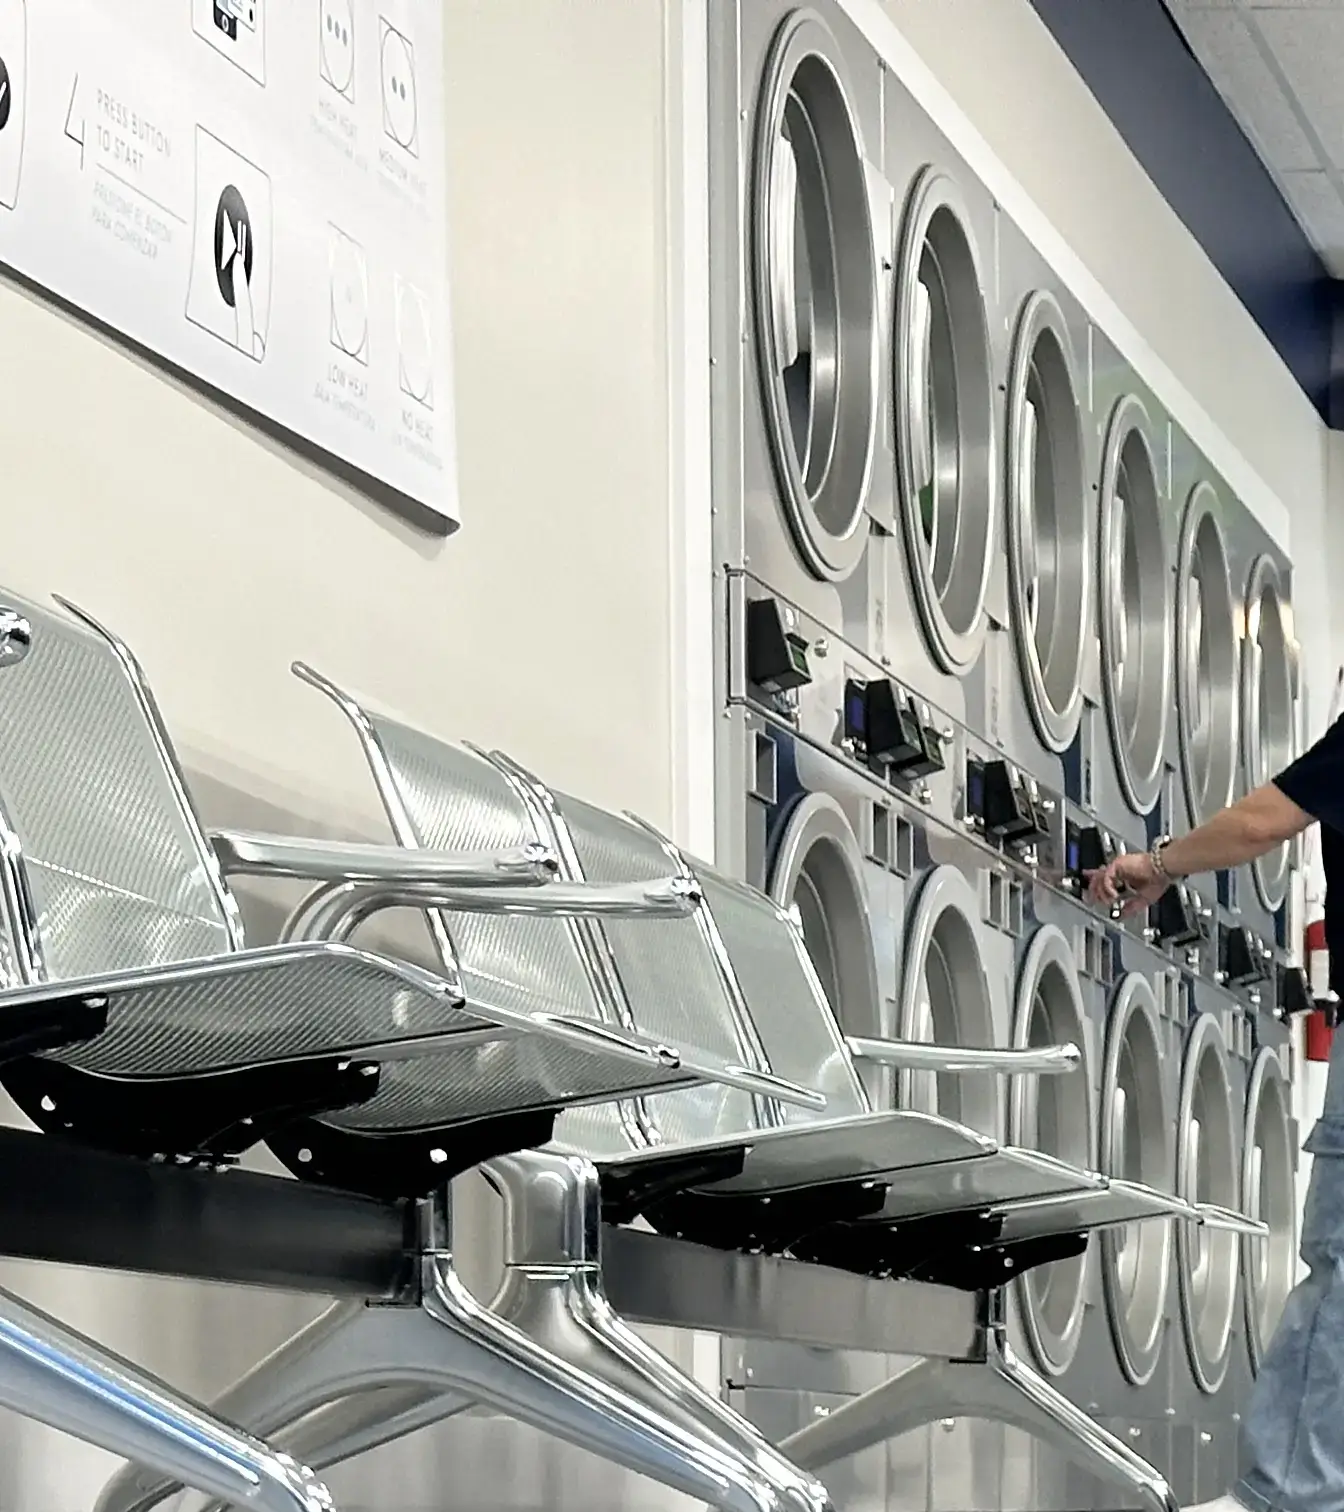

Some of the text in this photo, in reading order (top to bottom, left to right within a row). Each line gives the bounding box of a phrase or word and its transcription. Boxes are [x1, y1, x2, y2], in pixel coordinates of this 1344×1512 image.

[96, 88, 172, 158] PRESS BUTTON
[96, 124, 145, 174] TO START
